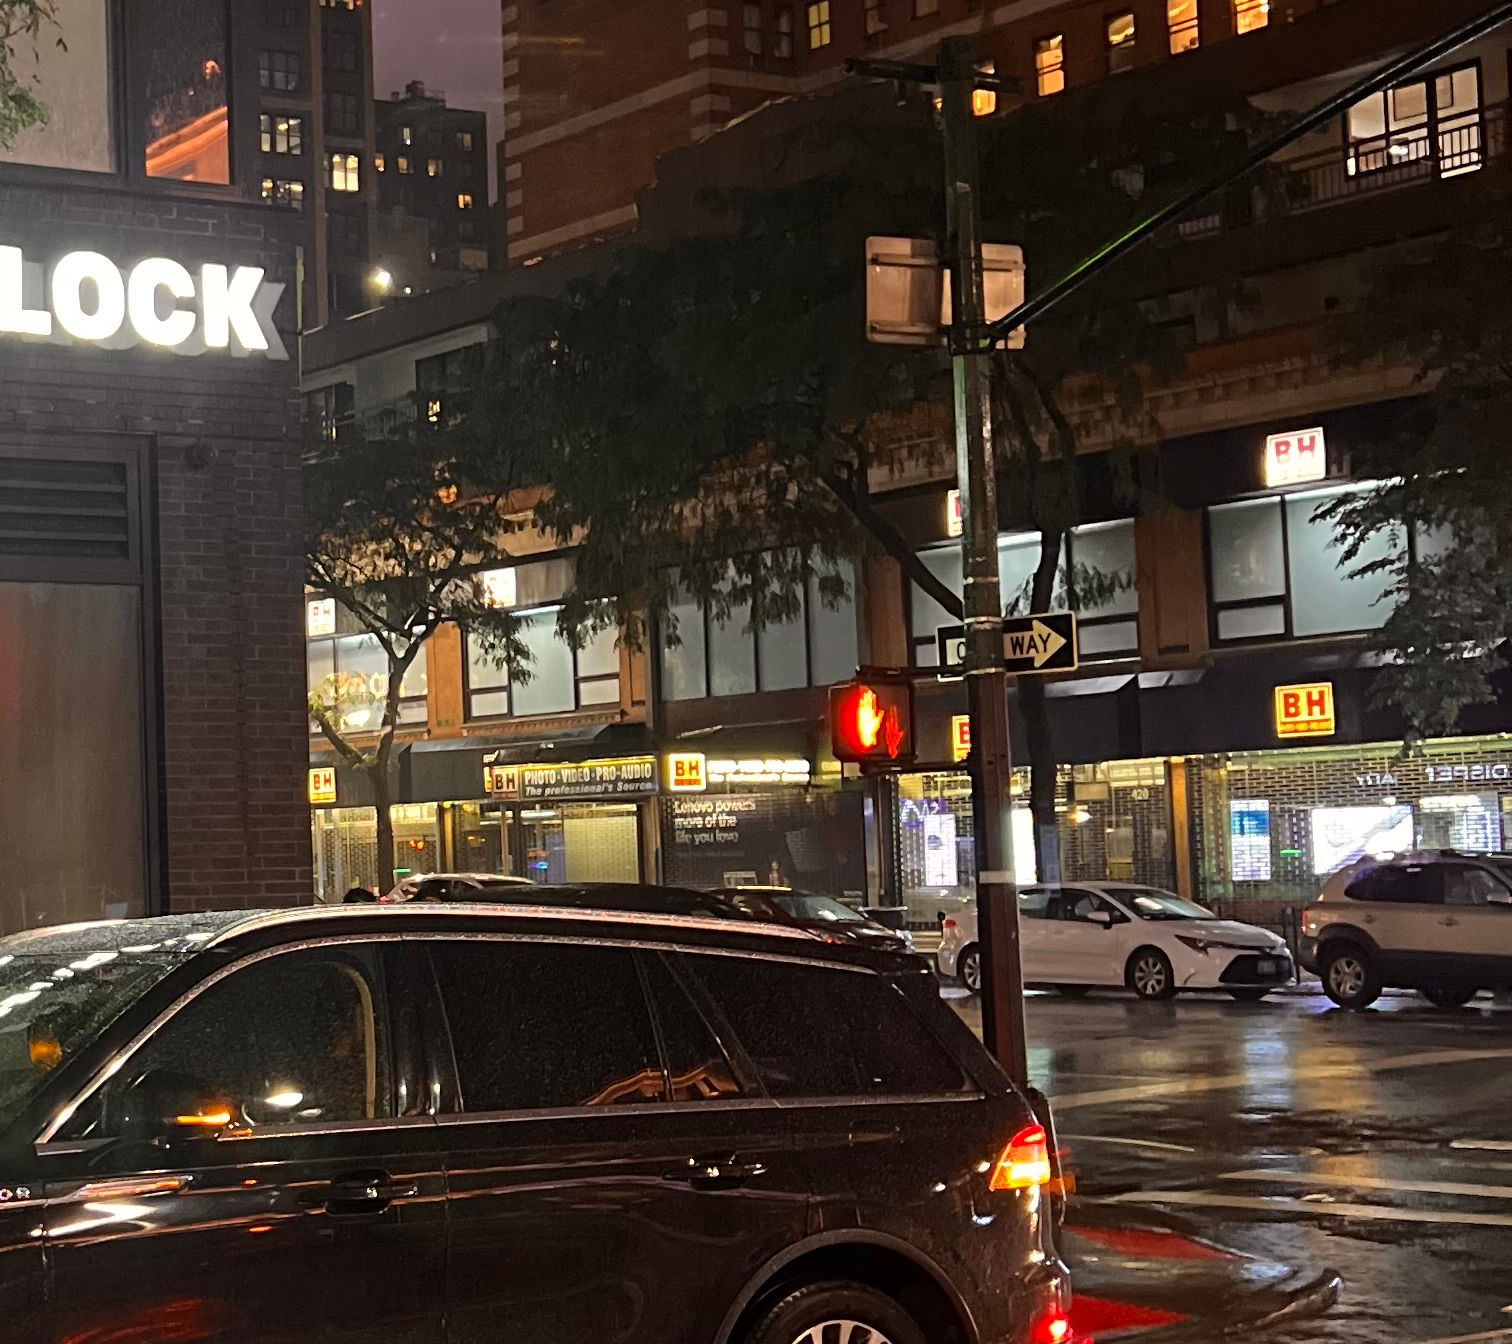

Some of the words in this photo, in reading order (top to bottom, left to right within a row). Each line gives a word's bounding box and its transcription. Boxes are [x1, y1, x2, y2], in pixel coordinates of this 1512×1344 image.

[1010, 633, 1051, 656] WAY
[525, 786, 542, 797] The
[674, 800, 714, 813] Lenovo
[704, 813, 716, 828] of
[717, 813, 738, 828] the
[693, 831, 714, 845] you
